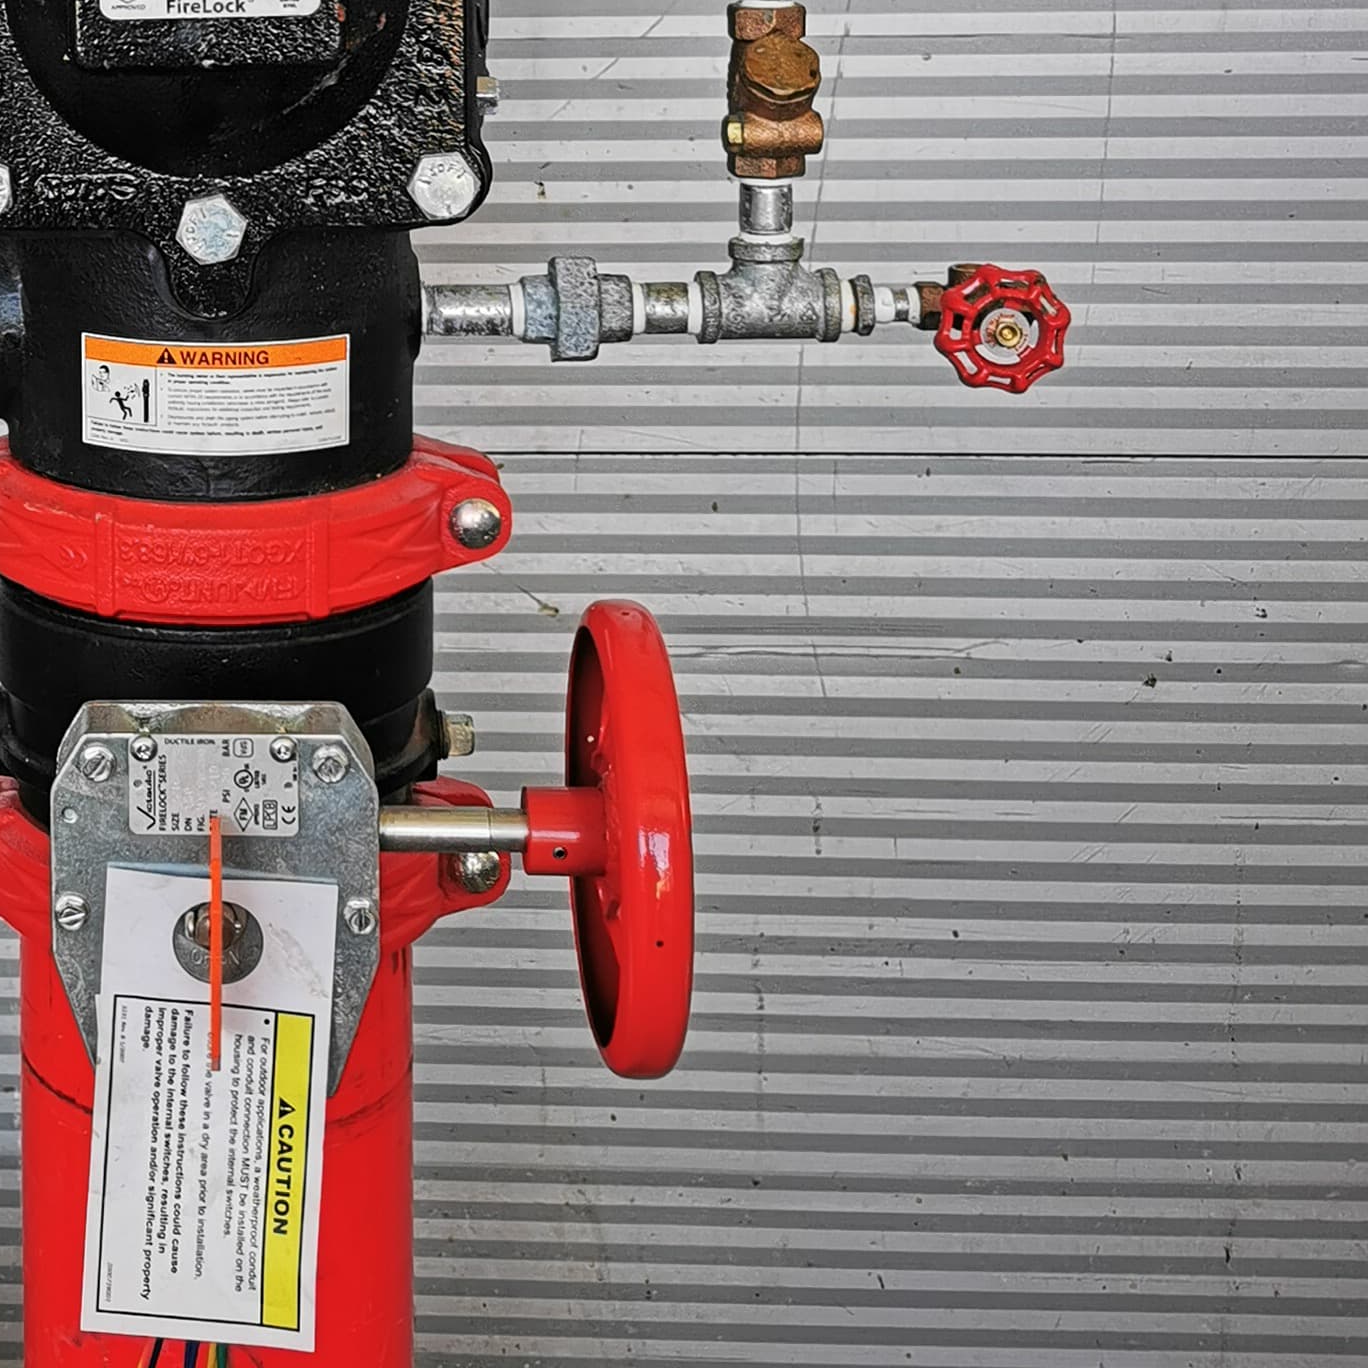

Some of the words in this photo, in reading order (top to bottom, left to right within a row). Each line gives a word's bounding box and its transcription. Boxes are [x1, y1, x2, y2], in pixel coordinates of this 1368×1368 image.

[181, 351, 269, 366] WARNING
[222, 739, 230, 757] BAR
[158, 754, 167, 783] SERIES
[222, 789, 230, 803] PSI
[171, 813, 180, 831] SIZE
[281, 805, 296, 825] CE
[140, 1005, 153, 1052] damage.
[153, 1006, 166, 1056] improper
[167, 1007, 179, 1051] damage
[182, 1008, 193, 1047] Failure
[168, 1053, 176, 1065] to
[182, 1048, 190, 1060] to
[229, 1033, 243, 1074] housing
[246, 1034, 256, 1055] and
[260, 1036, 270, 1055] For
[153, 1058, 163, 1088] valve
[167, 1067, 176, 1085] the
[179, 1063, 190, 1097] follow
[231, 1076, 240, 1087] to
[244, 1057, 254, 1095] conduit
[257, 1056, 268, 1096] outdoor
[164, 1087, 175, 1130] internal
[203, 1080, 213, 1108] valve
[228, 1089, 239, 1125] protect
[149, 1090, 161, 1143] operation
[178, 1099, 187, 1130] these
[203, 1110, 210, 1120] in
[241, 1096, 252, 1153] connection
[253, 1098, 265, 1163] applications,
[199, 1132, 210, 1150] dry
[228, 1128, 237, 1145] the
[148, 1145, 158, 1183] and/or
[160, 1132, 172, 1185] switches,
[174, 1132, 186, 1200] instructions
[199, 1151, 207, 1176] area
[226, 1147, 237, 1186] internal
[239, 1157, 250, 1189] MUST
[197, 1178, 208, 1203] prior
[272, 1123, 293, 1235] CAUTION
[142, 1185, 156, 1246] significant
[156, 1188, 169, 1239] resulting
[197, 1205, 206, 1216] to
[223, 1188, 233, 1238] switches.
[238, 1192, 247, 1206] be
[248, 1175, 261, 1248] weatherproof
[172, 1202, 182, 1235] could
[235, 1210, 246, 1255] installed
[158, 1242, 167, 1254] in
[170, 1237, 178, 1273] cause
[194, 1218, 206, 1279] installation.
[235, 1257, 242, 1272] on
[140, 1248, 152, 1300] property
[234, 1275, 244, 1292] the
[247, 1250, 257, 1290] conduit
